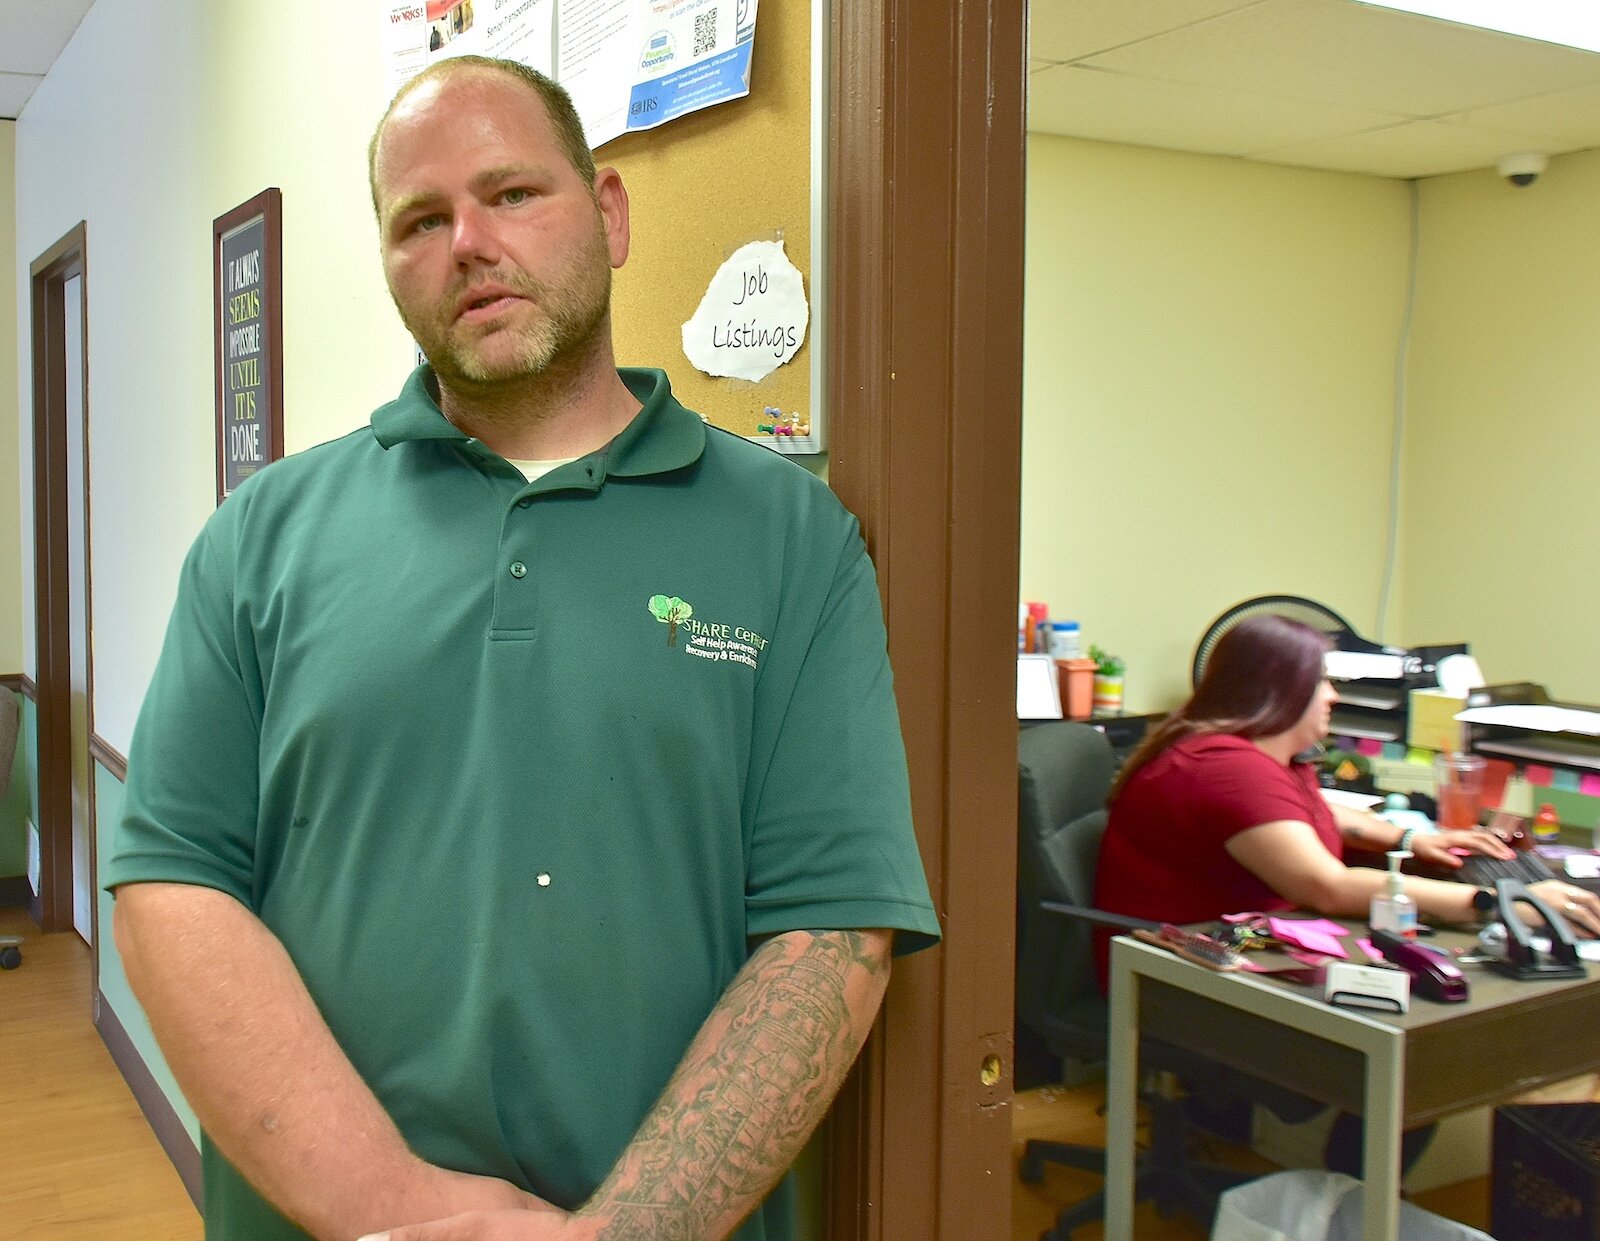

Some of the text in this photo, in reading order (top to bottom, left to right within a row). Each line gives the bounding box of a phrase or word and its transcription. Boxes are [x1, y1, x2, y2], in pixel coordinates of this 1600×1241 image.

[642, 52, 674, 69] Opportunity
[643, 96, 658, 113] IRS
[228, 249, 260, 293] IT ALWAYS
[732, 263, 768, 306] Job
[229, 288, 260, 326] SEEMS
[229, 323, 260, 359] IMPOSSIBLE
[712, 318, 797, 358] Listings
[229, 358, 261, 391] UNTIL
[235, 390, 256, 421] IT IS
[682, 618, 731, 640] SHARE
[690, 634, 707, 647] Self
[706, 637, 727, 651] Help
[685, 643, 720, 662] Recovery
[720, 650, 728, 661] &
